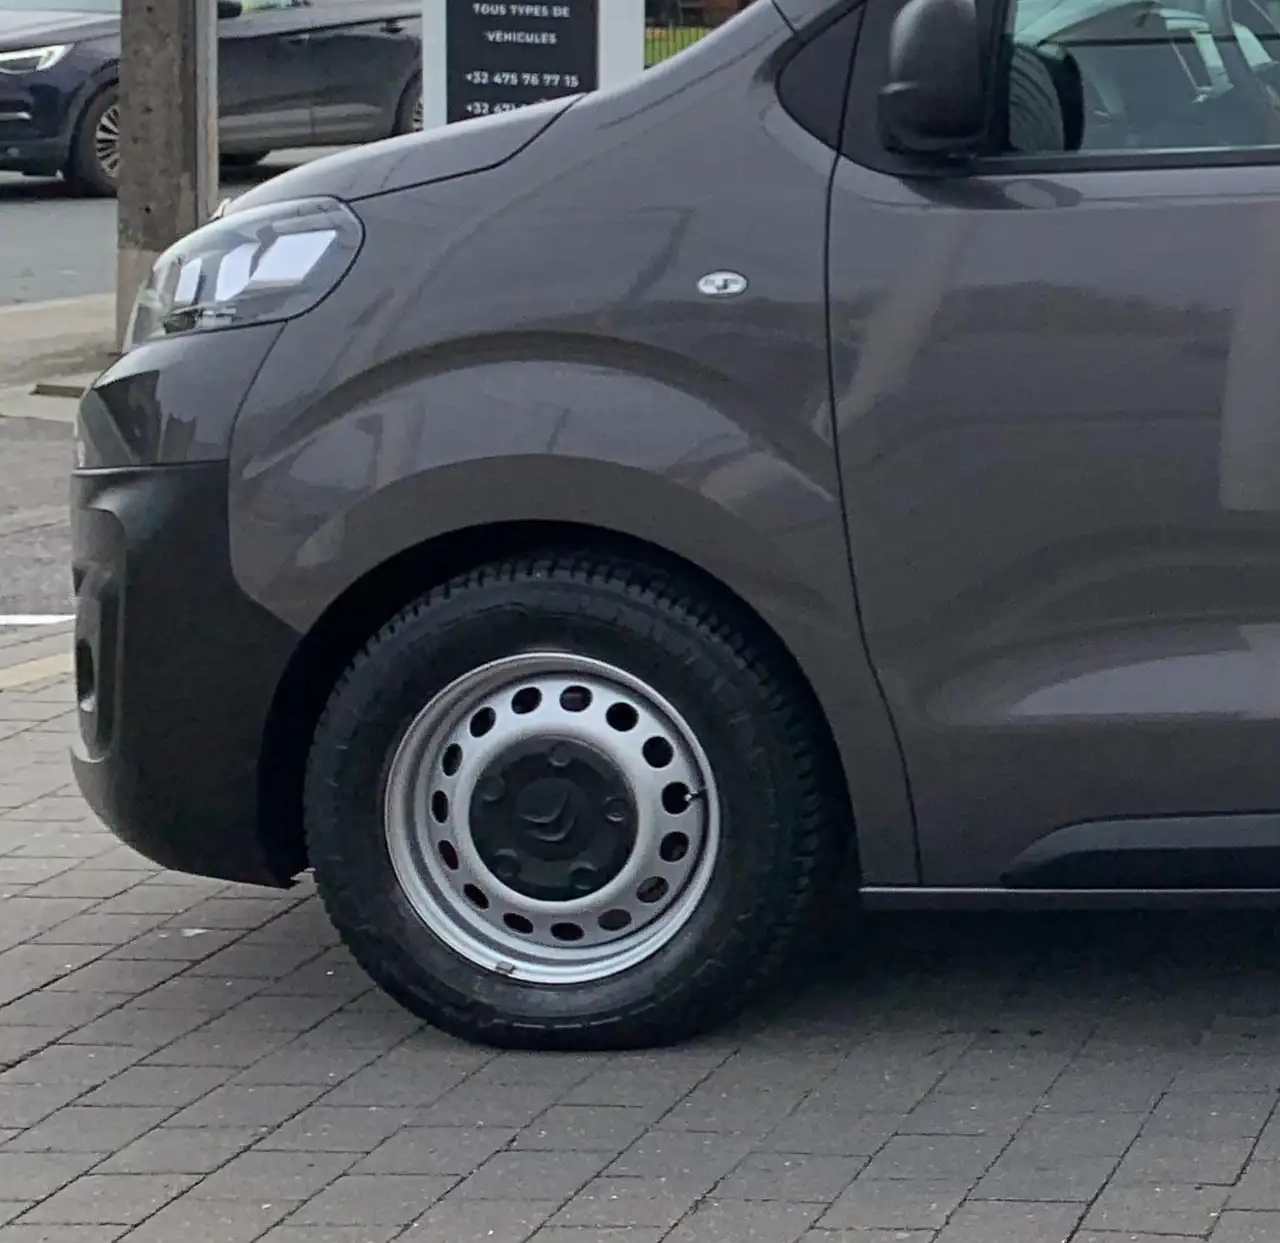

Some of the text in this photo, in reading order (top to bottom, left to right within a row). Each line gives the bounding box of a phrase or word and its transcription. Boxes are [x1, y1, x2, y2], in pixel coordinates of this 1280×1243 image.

[472, 3, 570, 18] TOUS TYPES DE
[465, 70, 489, 85] +32
